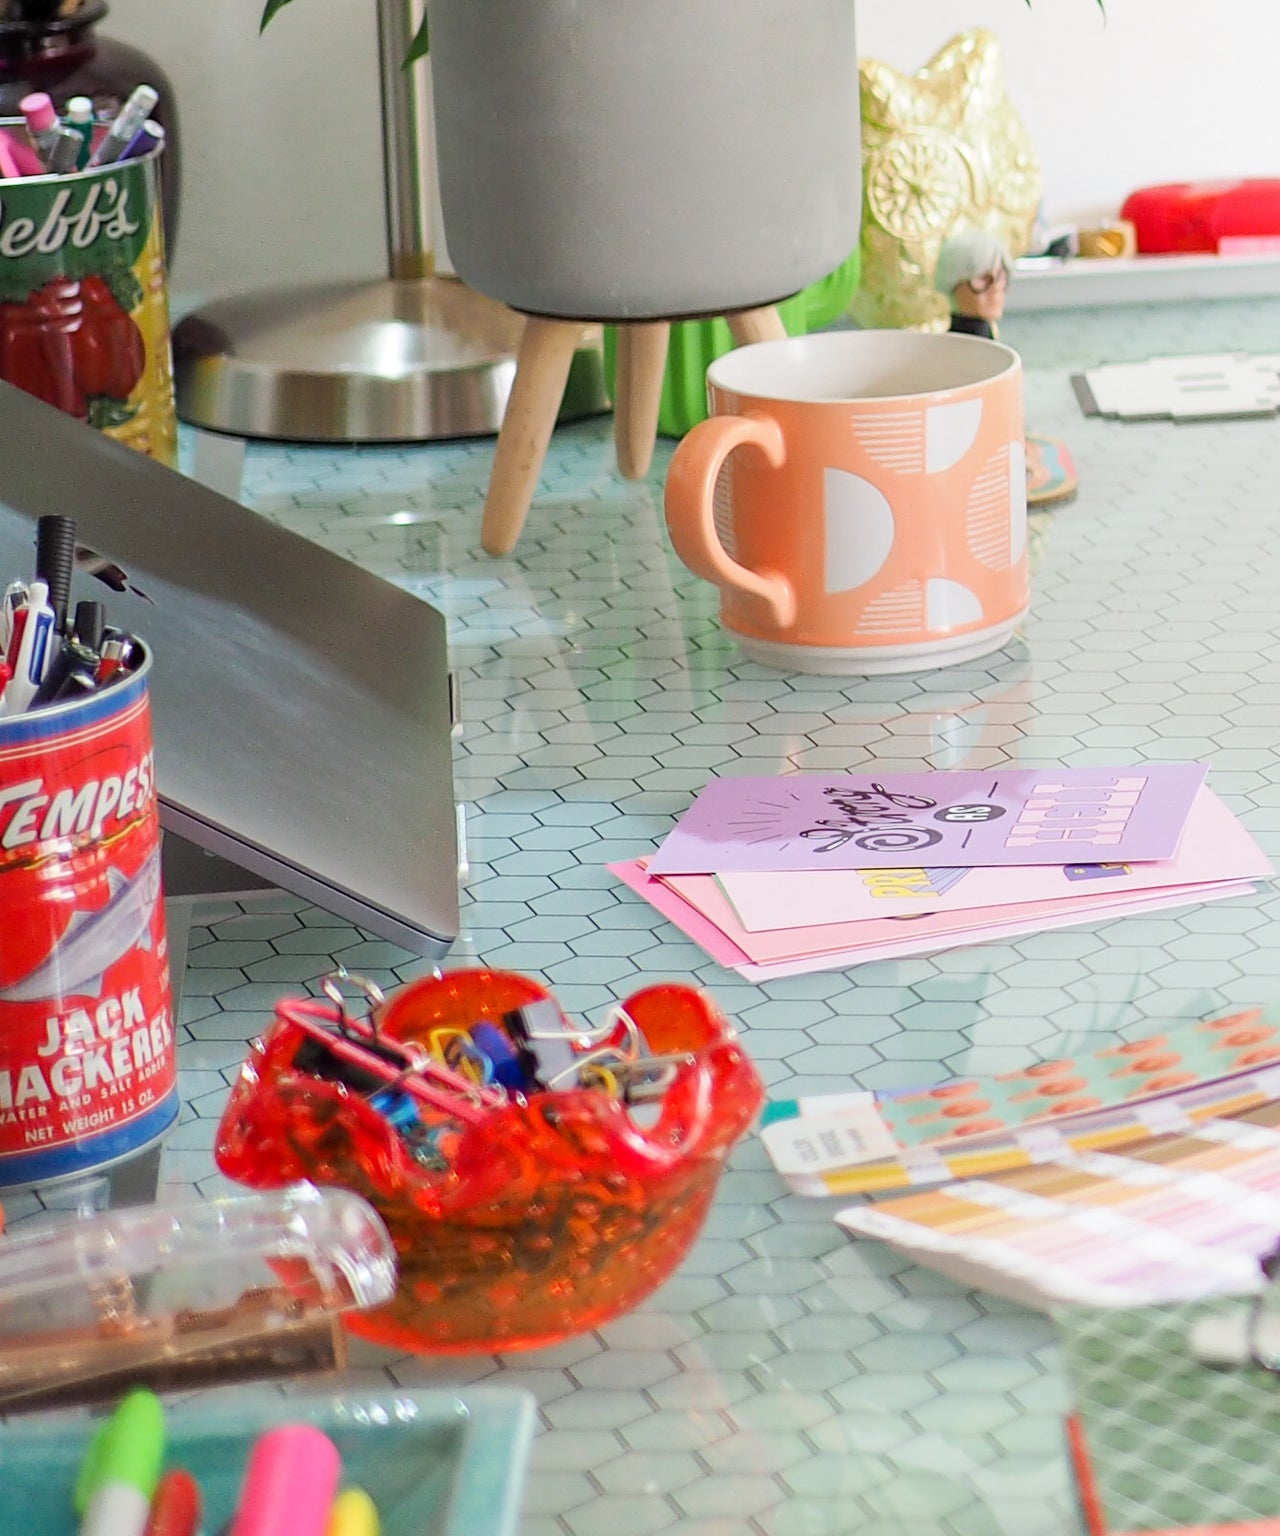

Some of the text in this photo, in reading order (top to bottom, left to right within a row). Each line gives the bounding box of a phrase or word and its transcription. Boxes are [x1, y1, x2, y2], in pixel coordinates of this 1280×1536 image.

[1003, 776, 1150, 849] HELL
[37, 986, 146, 1057] JACK
[25, 1125, 54, 1144] NET
[63, 1108, 115, 1135] WEIGHT
[122, 1098, 136, 1115] 15
[59, 1093, 92, 1113] AND
[101, 1077, 132, 1100] SALT
